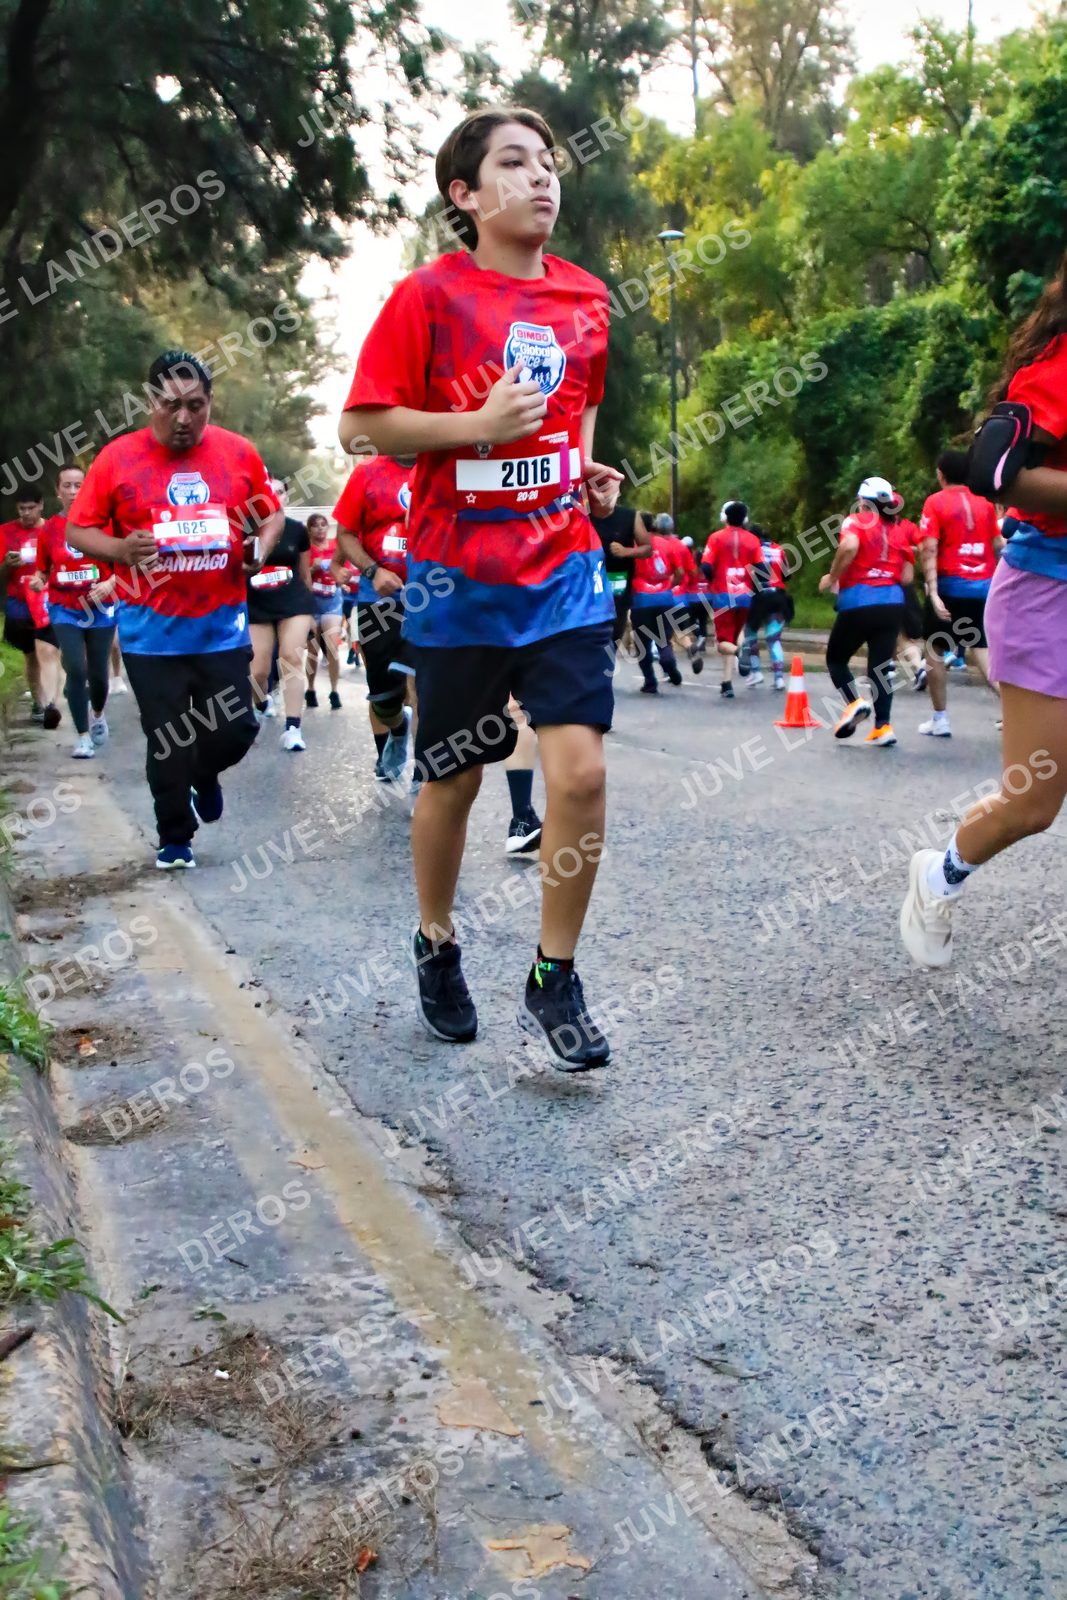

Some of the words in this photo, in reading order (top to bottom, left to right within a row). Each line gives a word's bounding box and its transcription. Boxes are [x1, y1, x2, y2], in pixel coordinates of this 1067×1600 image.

[516, 329, 549, 342] BIMBO
[519, 342, 551, 357] Global
[501, 456, 551, 488] 2016
[177, 520, 207, 535] 1625
[397, 538, 408, 550] 18
